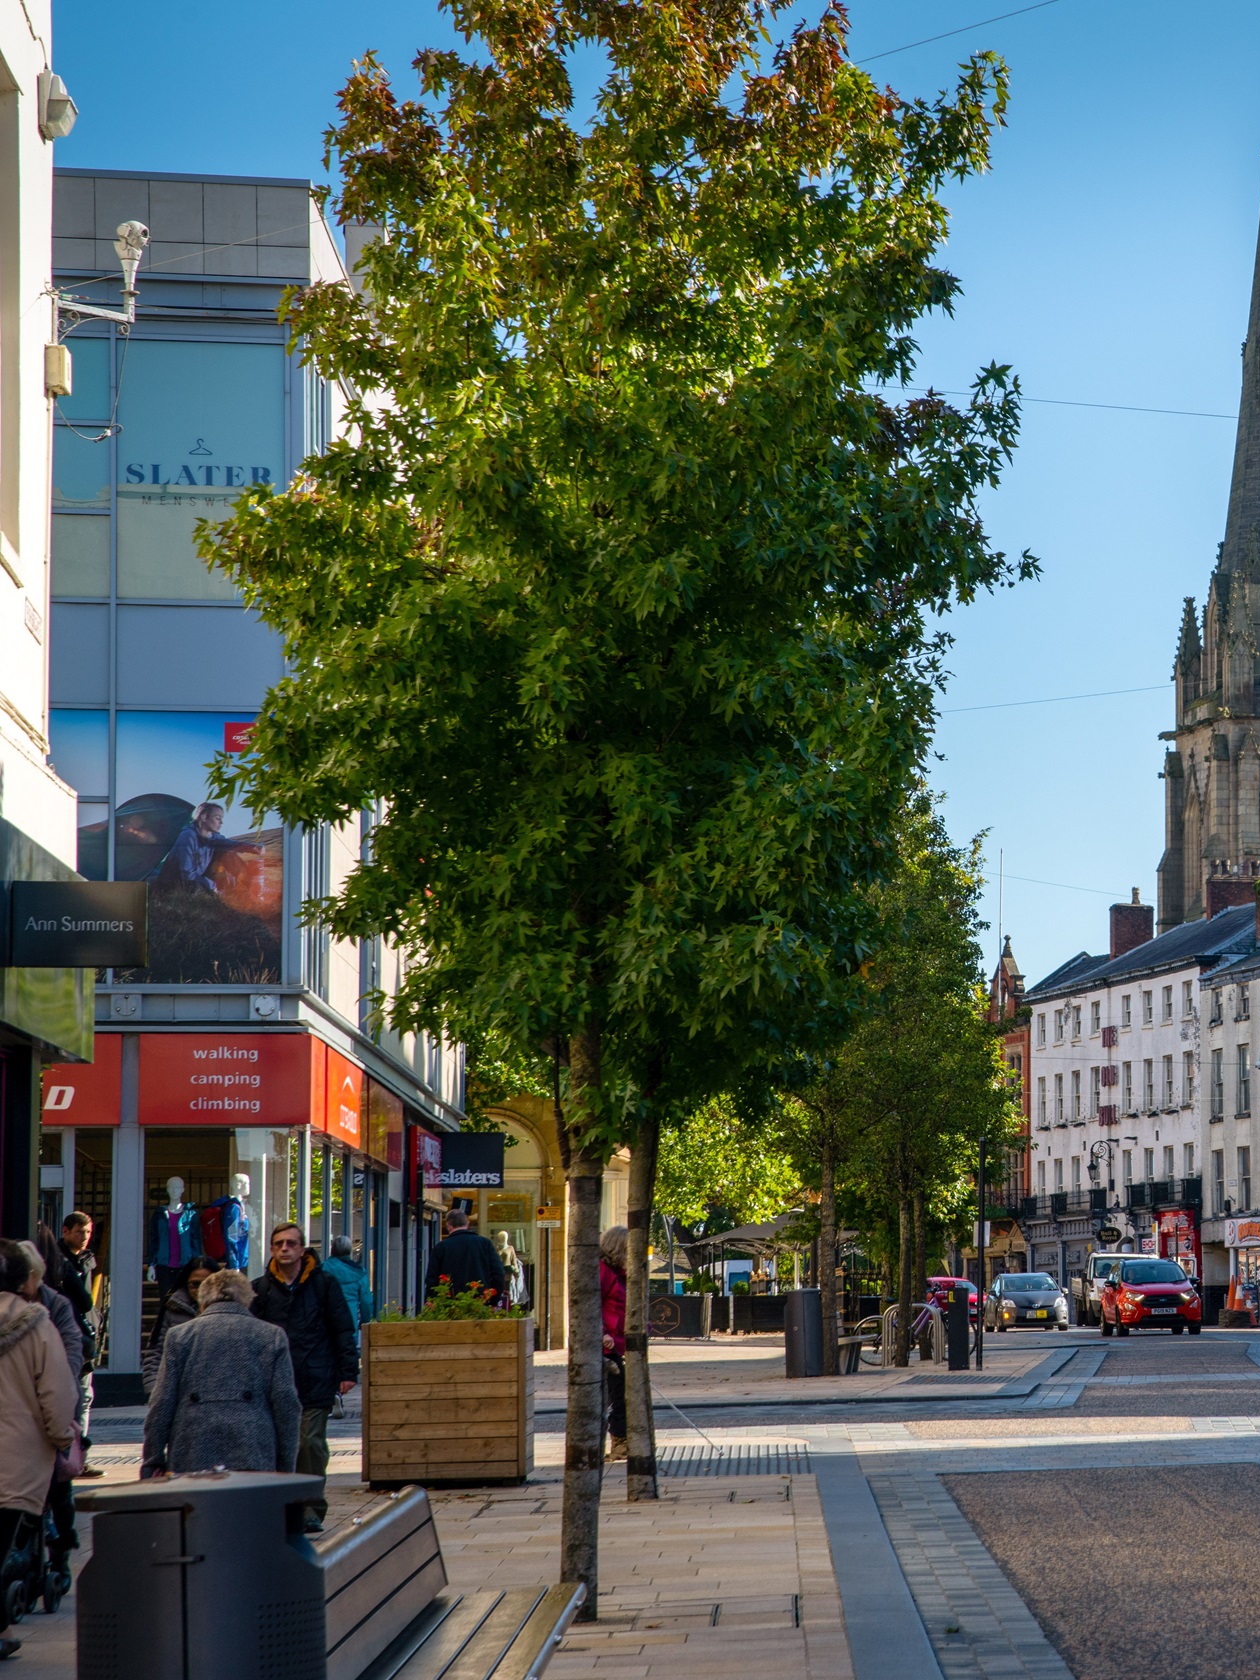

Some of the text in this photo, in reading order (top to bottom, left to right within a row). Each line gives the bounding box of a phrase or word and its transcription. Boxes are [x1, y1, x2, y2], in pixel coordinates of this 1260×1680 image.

[126, 463, 271, 487] SLATER
[142, 495, 231, 507] MENSWE
[24, 915, 134, 932] Ann Summers
[193, 1046, 259, 1063] walking
[190, 1072, 261, 1087] camping
[190, 1097, 261, 1113] climbing
[441, 1168, 501, 1185] slaters
